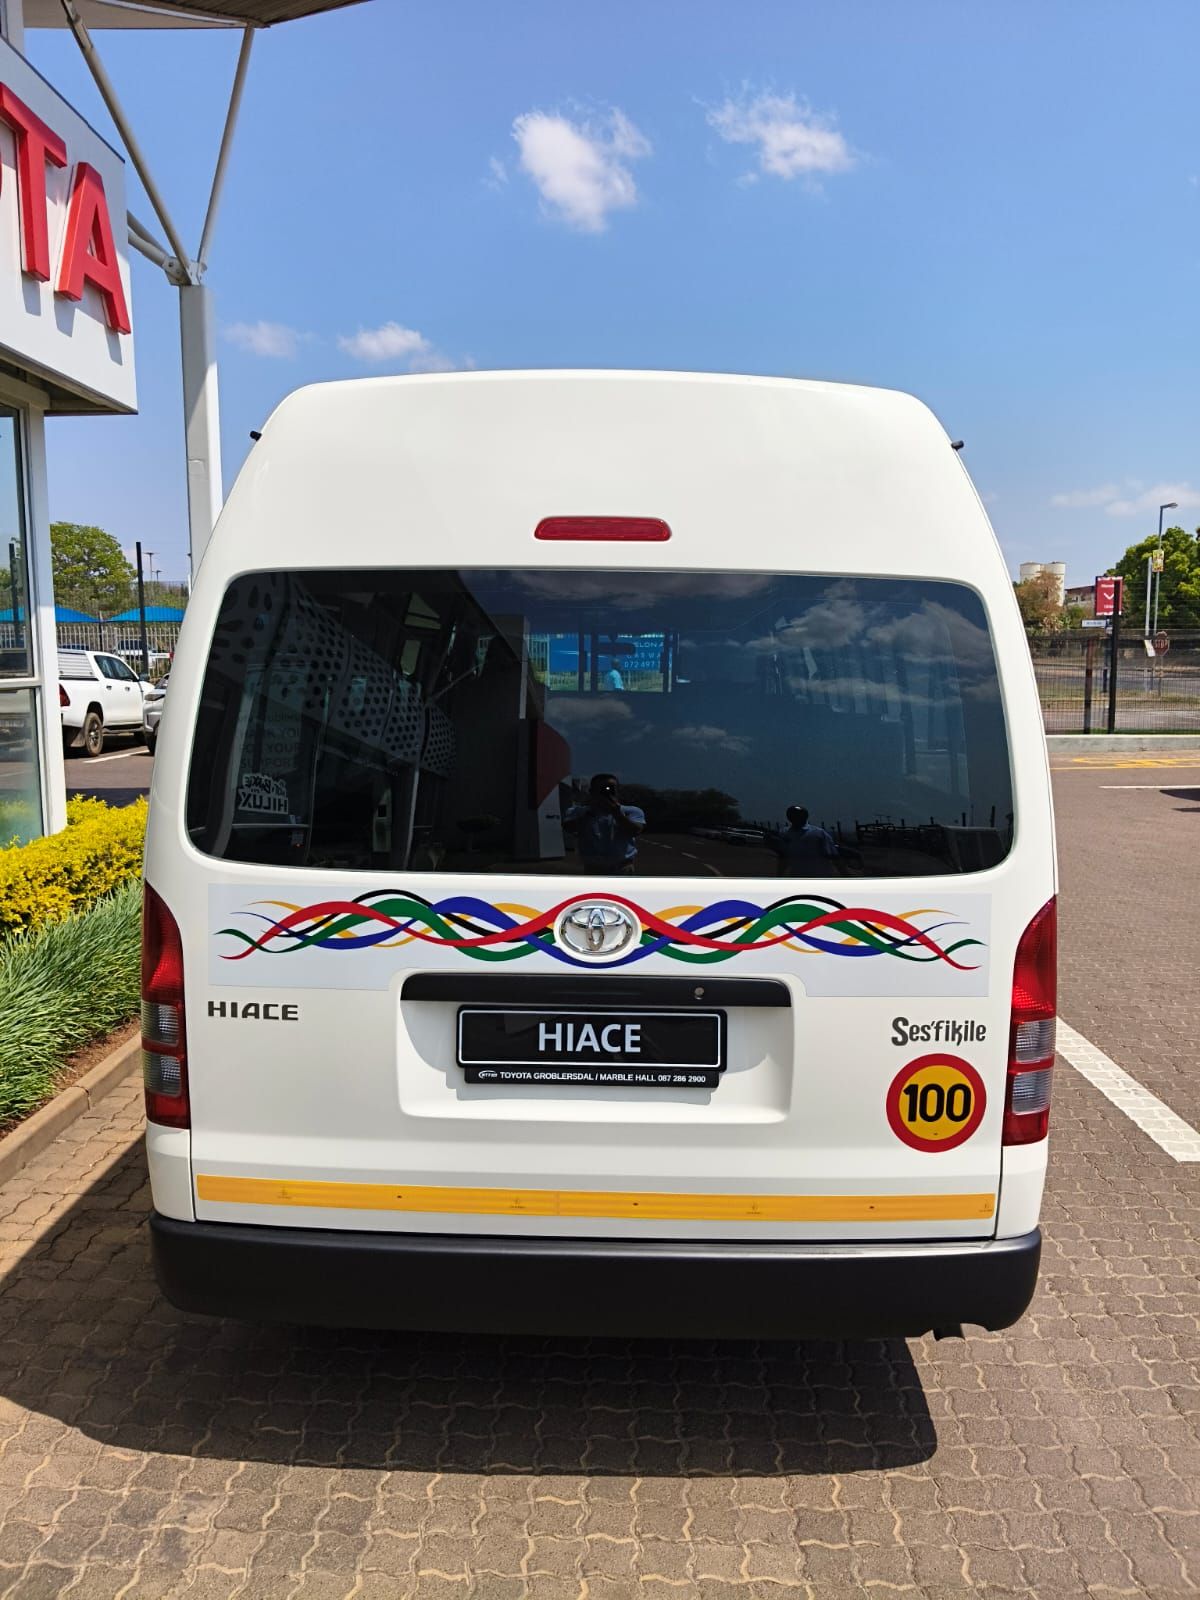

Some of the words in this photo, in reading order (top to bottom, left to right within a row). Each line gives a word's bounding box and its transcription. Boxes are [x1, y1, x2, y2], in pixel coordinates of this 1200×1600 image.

[0, 81, 131, 334] TA
[208, 1001, 299, 1021] HIACE
[538, 1022, 641, 1053] HIACE
[500, 1071, 532, 1080] TOYOTA
[533, 1072, 594, 1081] GROBLERSDAL
[599, 1073, 634, 1081] MARBLE
[635, 1074, 657, 1082] HALL
[658, 1074, 672, 1082] 087
[688, 1075, 706, 1083] 2900
[903, 1083, 972, 1122] 100
